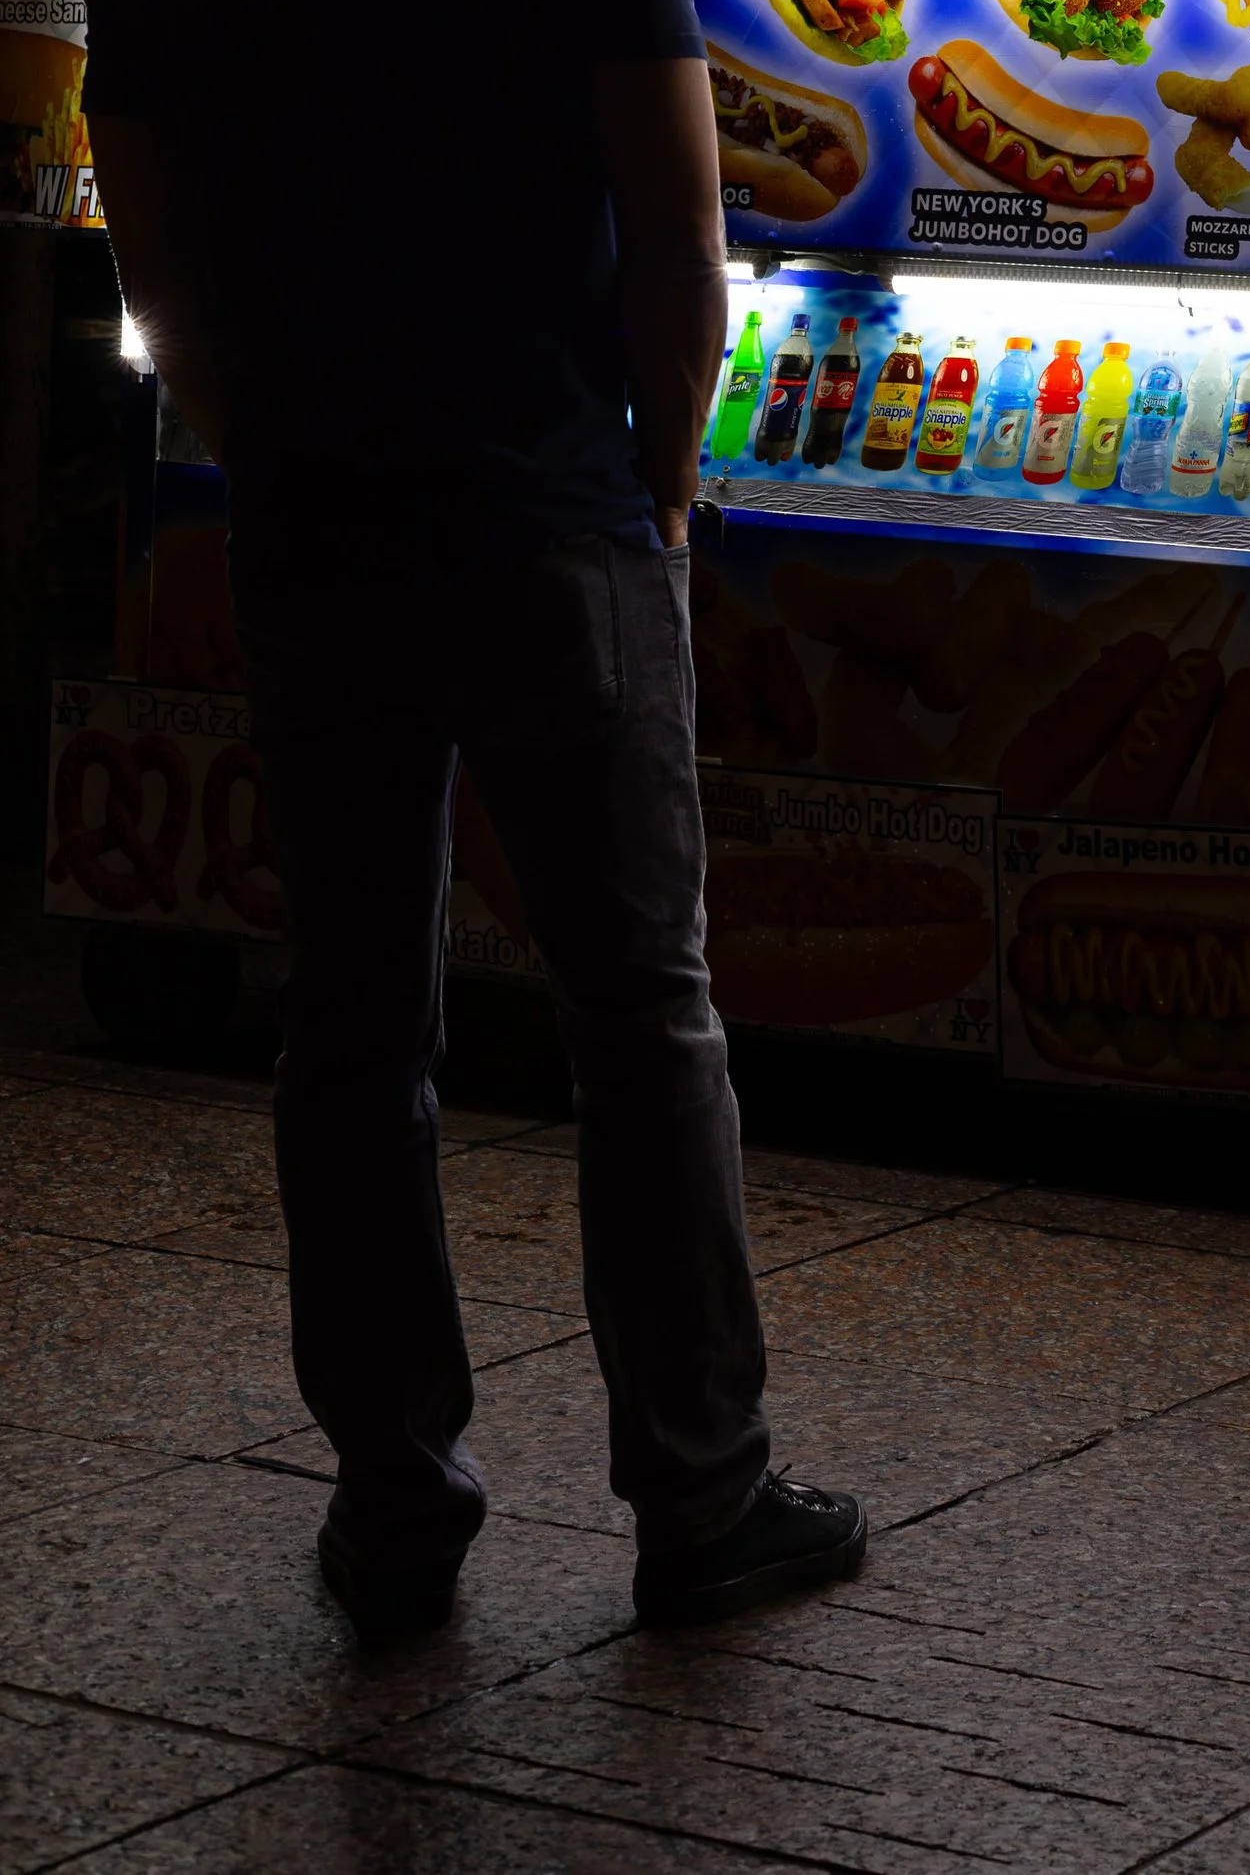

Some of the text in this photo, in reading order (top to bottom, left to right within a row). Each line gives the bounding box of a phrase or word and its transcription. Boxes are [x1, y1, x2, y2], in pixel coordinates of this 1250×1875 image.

[915, 192, 1043, 219] NEW YORK'S
[912, 218, 1084, 247] JUMBOHOT DOG
[1189, 240, 1235, 256] STICKS
[872, 403, 914, 422] Snapple
[1143, 399, 1169, 410] Spring
[925, 410, 967, 429] Snapple
[770, 790, 985, 855] Jumbo Hot Dog
[1058, 829, 1197, 868] Jalapeno
